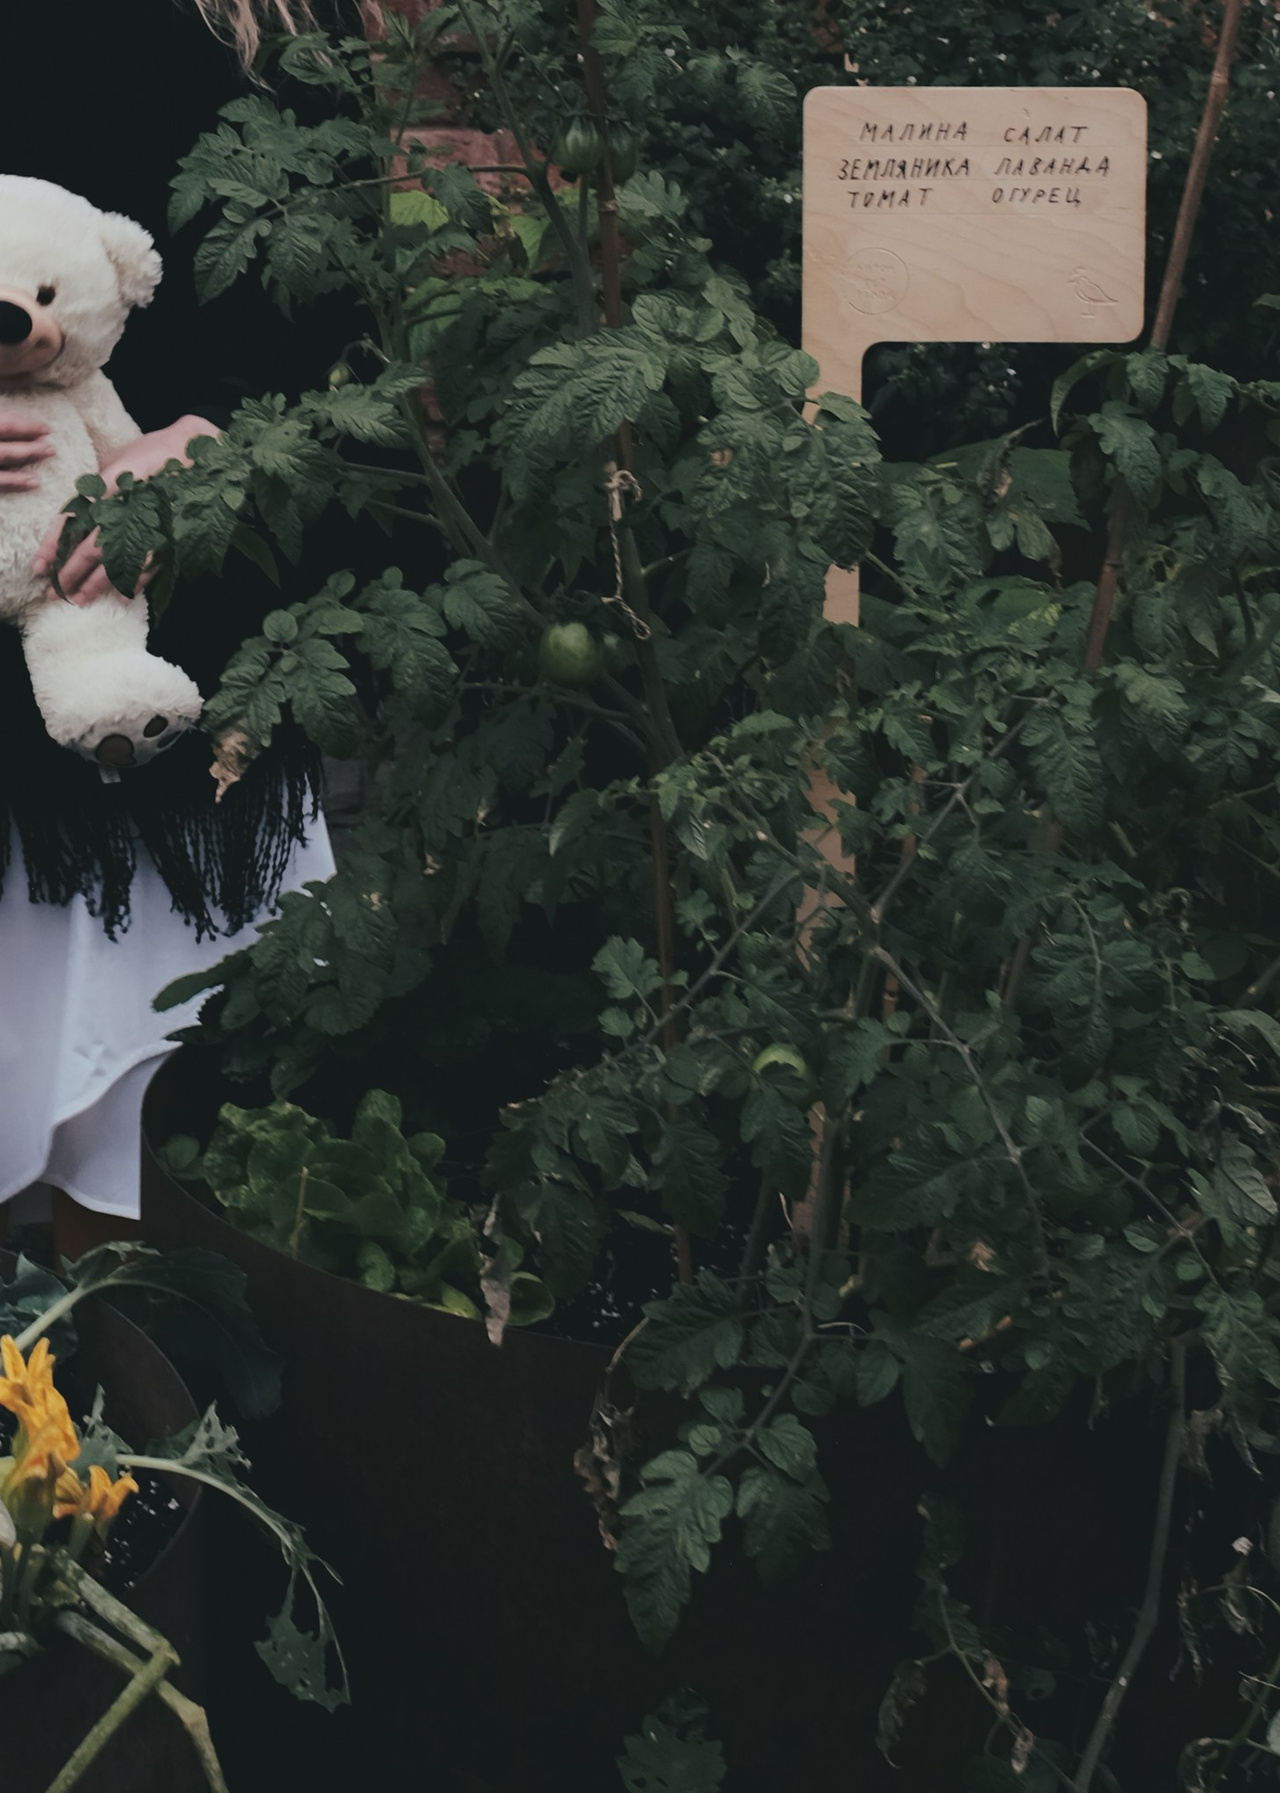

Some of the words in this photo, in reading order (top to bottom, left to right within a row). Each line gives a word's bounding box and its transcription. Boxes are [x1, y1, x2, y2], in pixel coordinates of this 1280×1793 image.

[858, 120, 968, 143] МАЛИНА
[1003, 125, 1088, 144] САЛАТ
[837, 157, 971, 181] ЗЕМЛЯНИКА
[992, 155, 1111, 177] ЛАВАНДА
[848, 187, 933, 209] ТОМАТ
[991, 187, 1081, 208] ОГУРЕЦ
